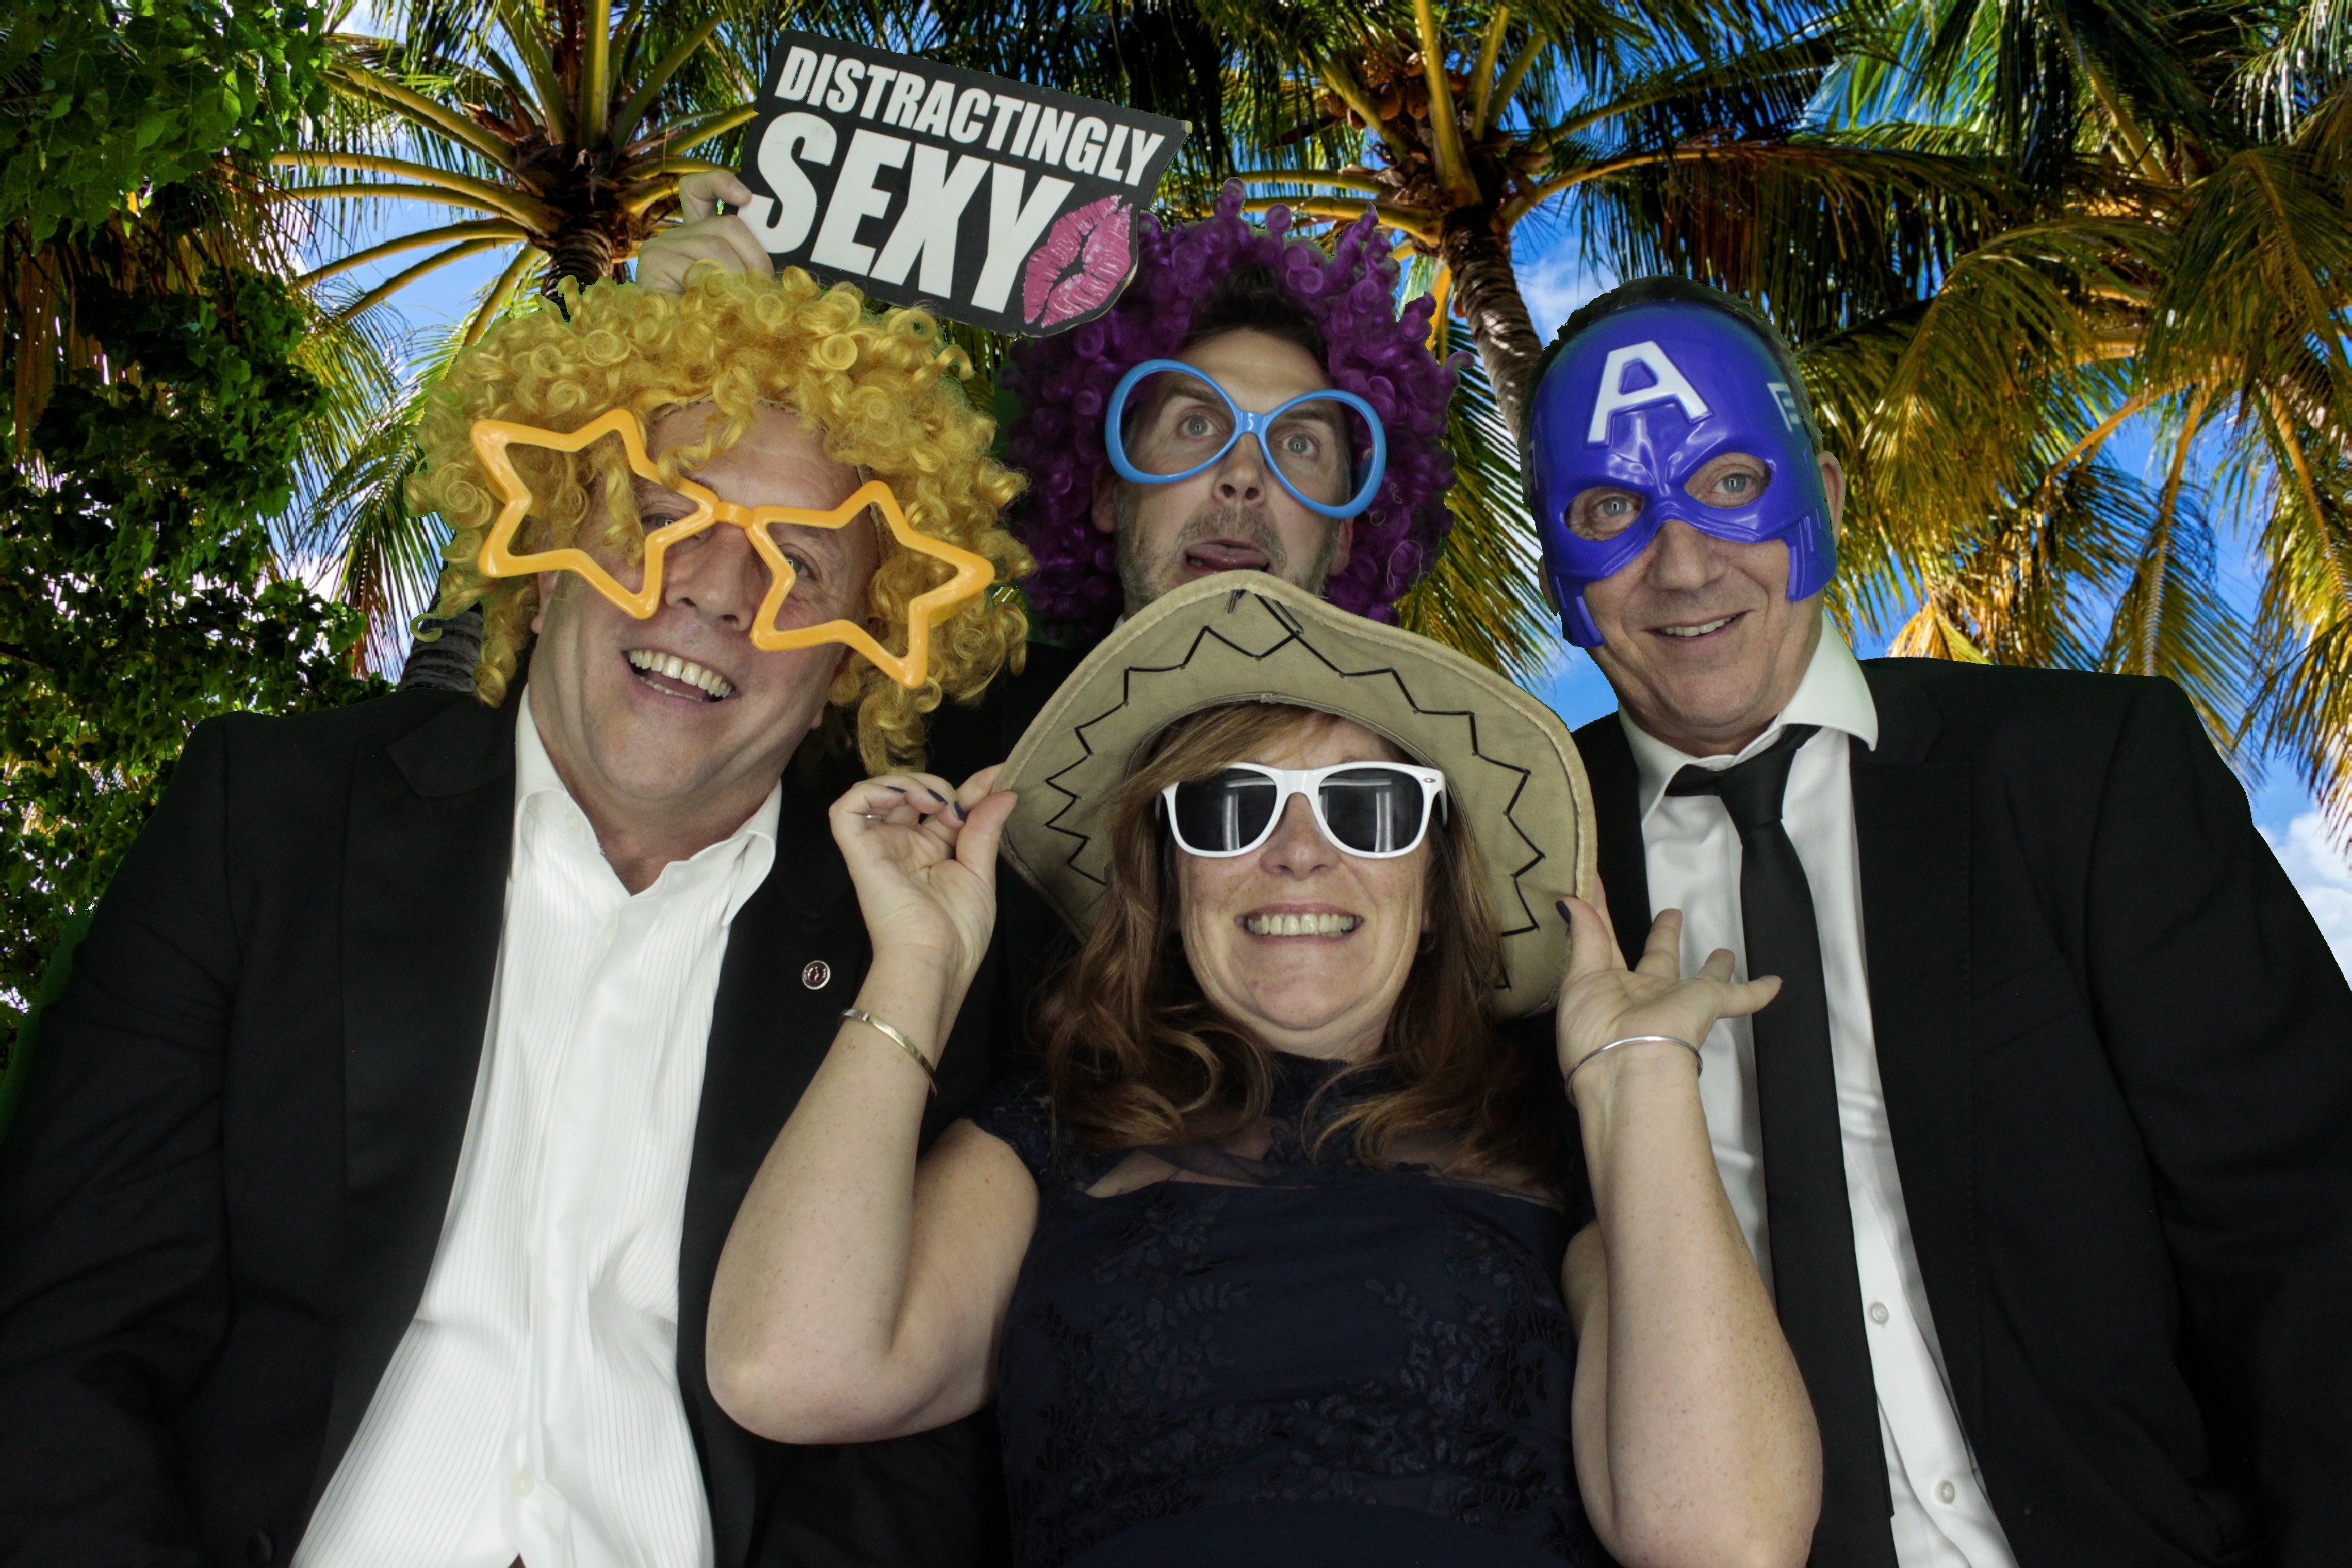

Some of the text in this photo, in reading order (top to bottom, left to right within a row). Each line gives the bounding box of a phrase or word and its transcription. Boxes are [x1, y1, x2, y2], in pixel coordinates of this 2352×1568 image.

[774, 46, 1165, 186] DISTRACTINGLY
[738, 112, 1075, 314] SEXY
[1587, 340, 1710, 444] A
